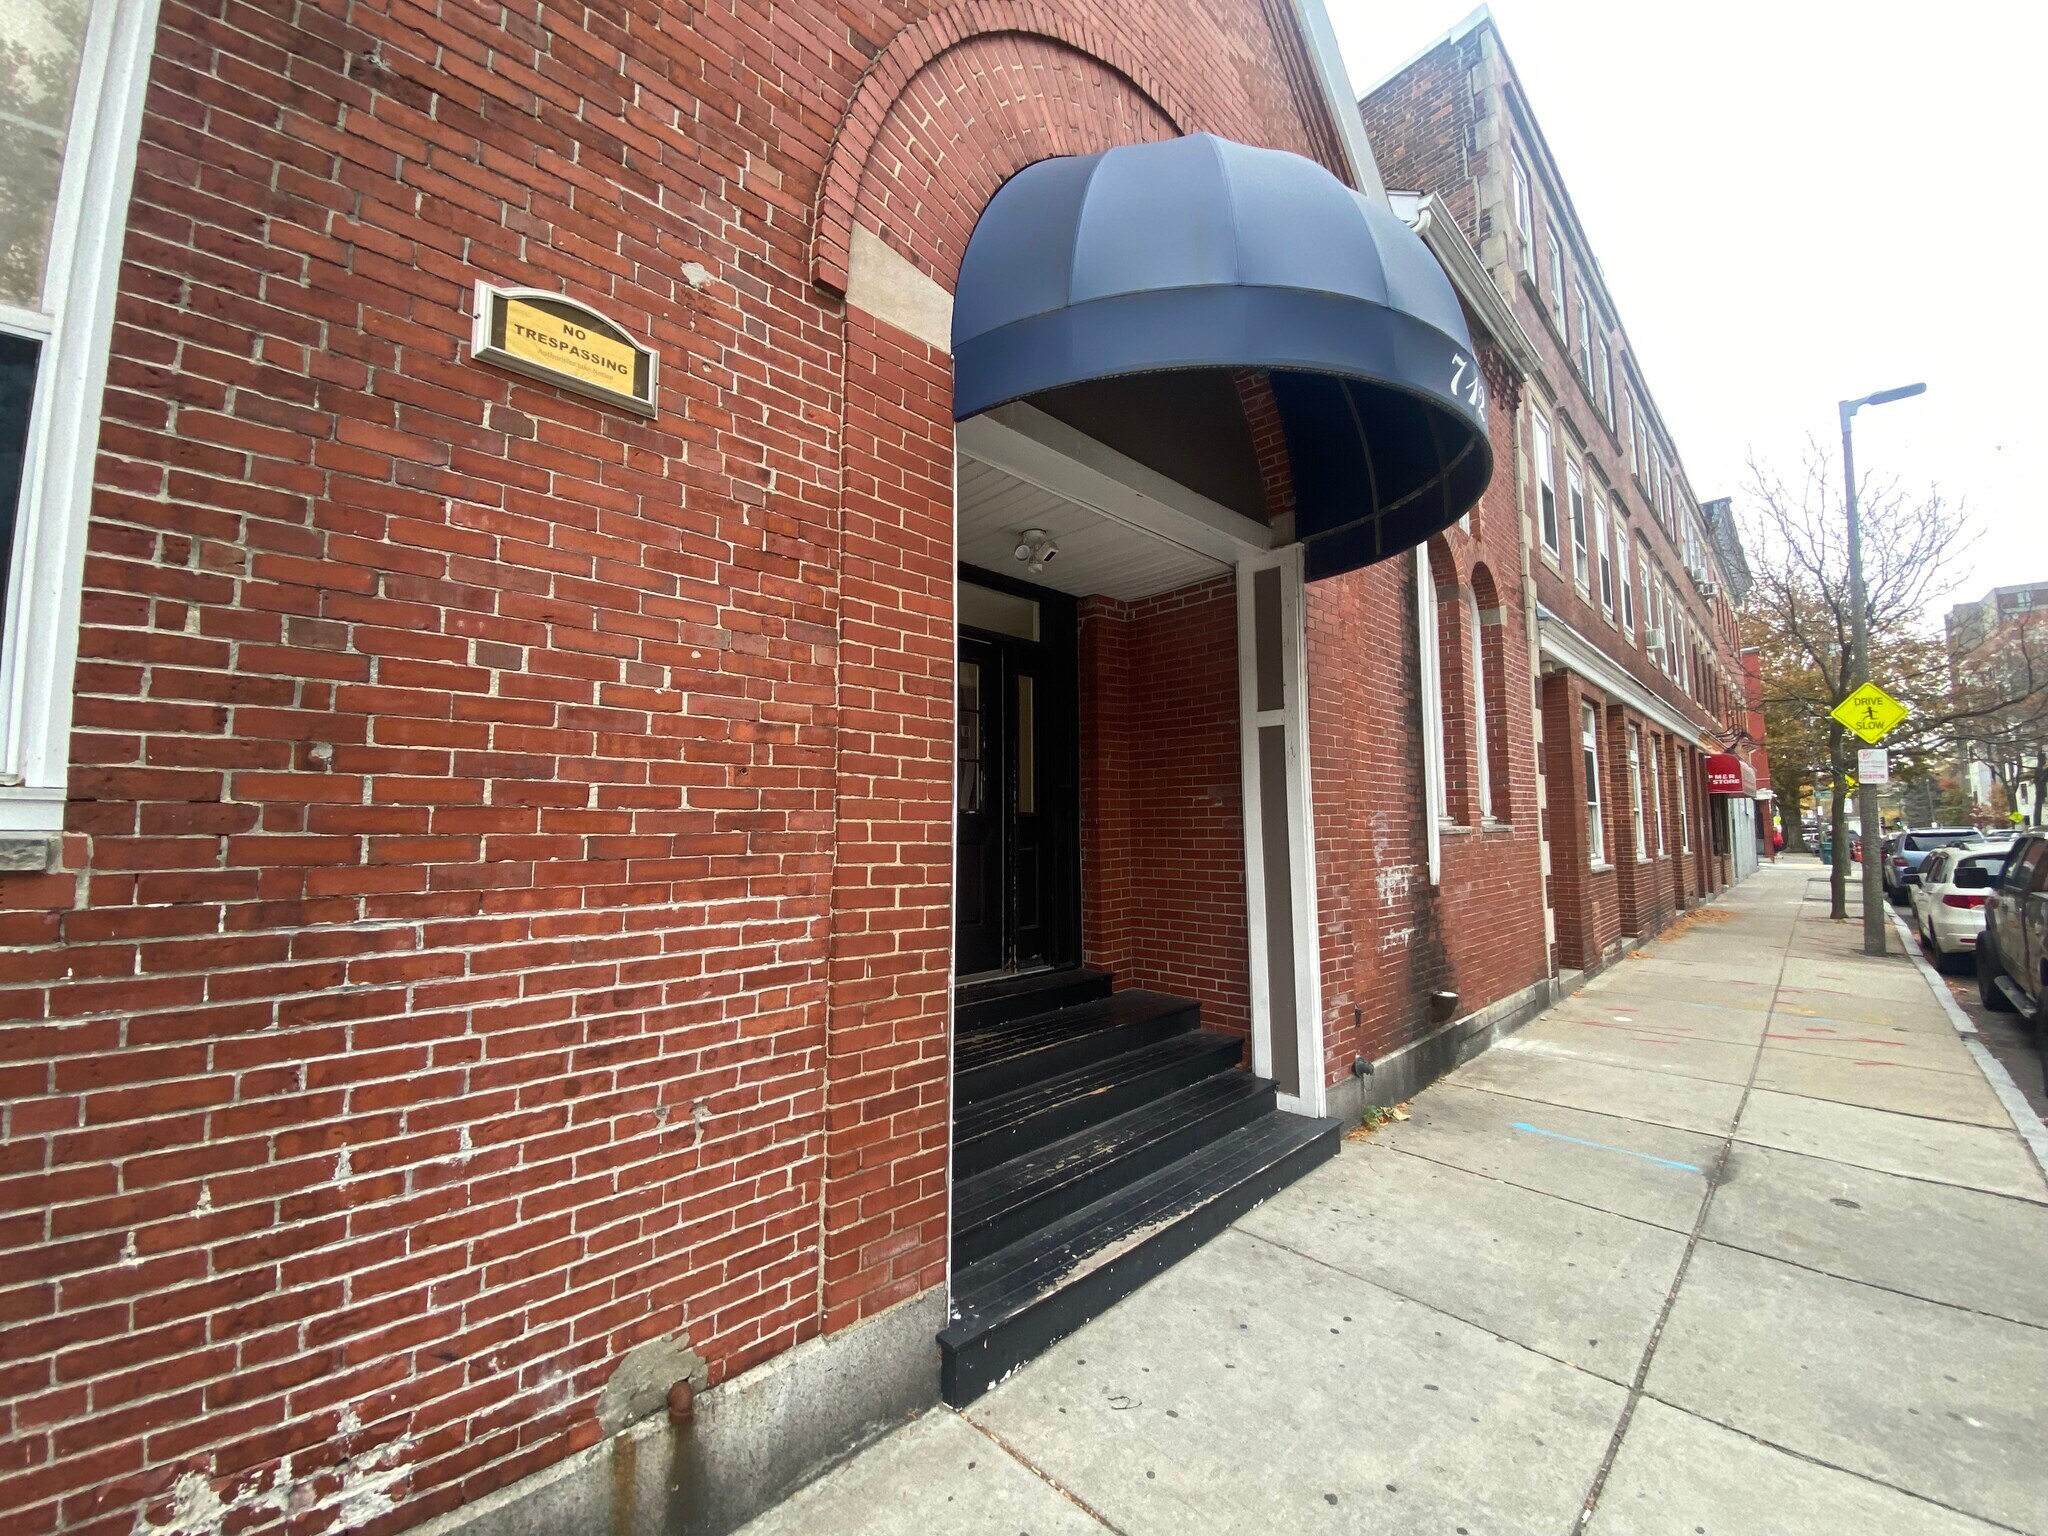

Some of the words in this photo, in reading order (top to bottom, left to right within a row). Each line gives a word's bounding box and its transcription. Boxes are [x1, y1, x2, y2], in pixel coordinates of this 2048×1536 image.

[563, 324, 586, 341] NO
[514, 324, 628, 374] TRESPASSING
[1854, 697, 1884, 706] DRIVE
[1856, 721, 1885, 730] SLOW
